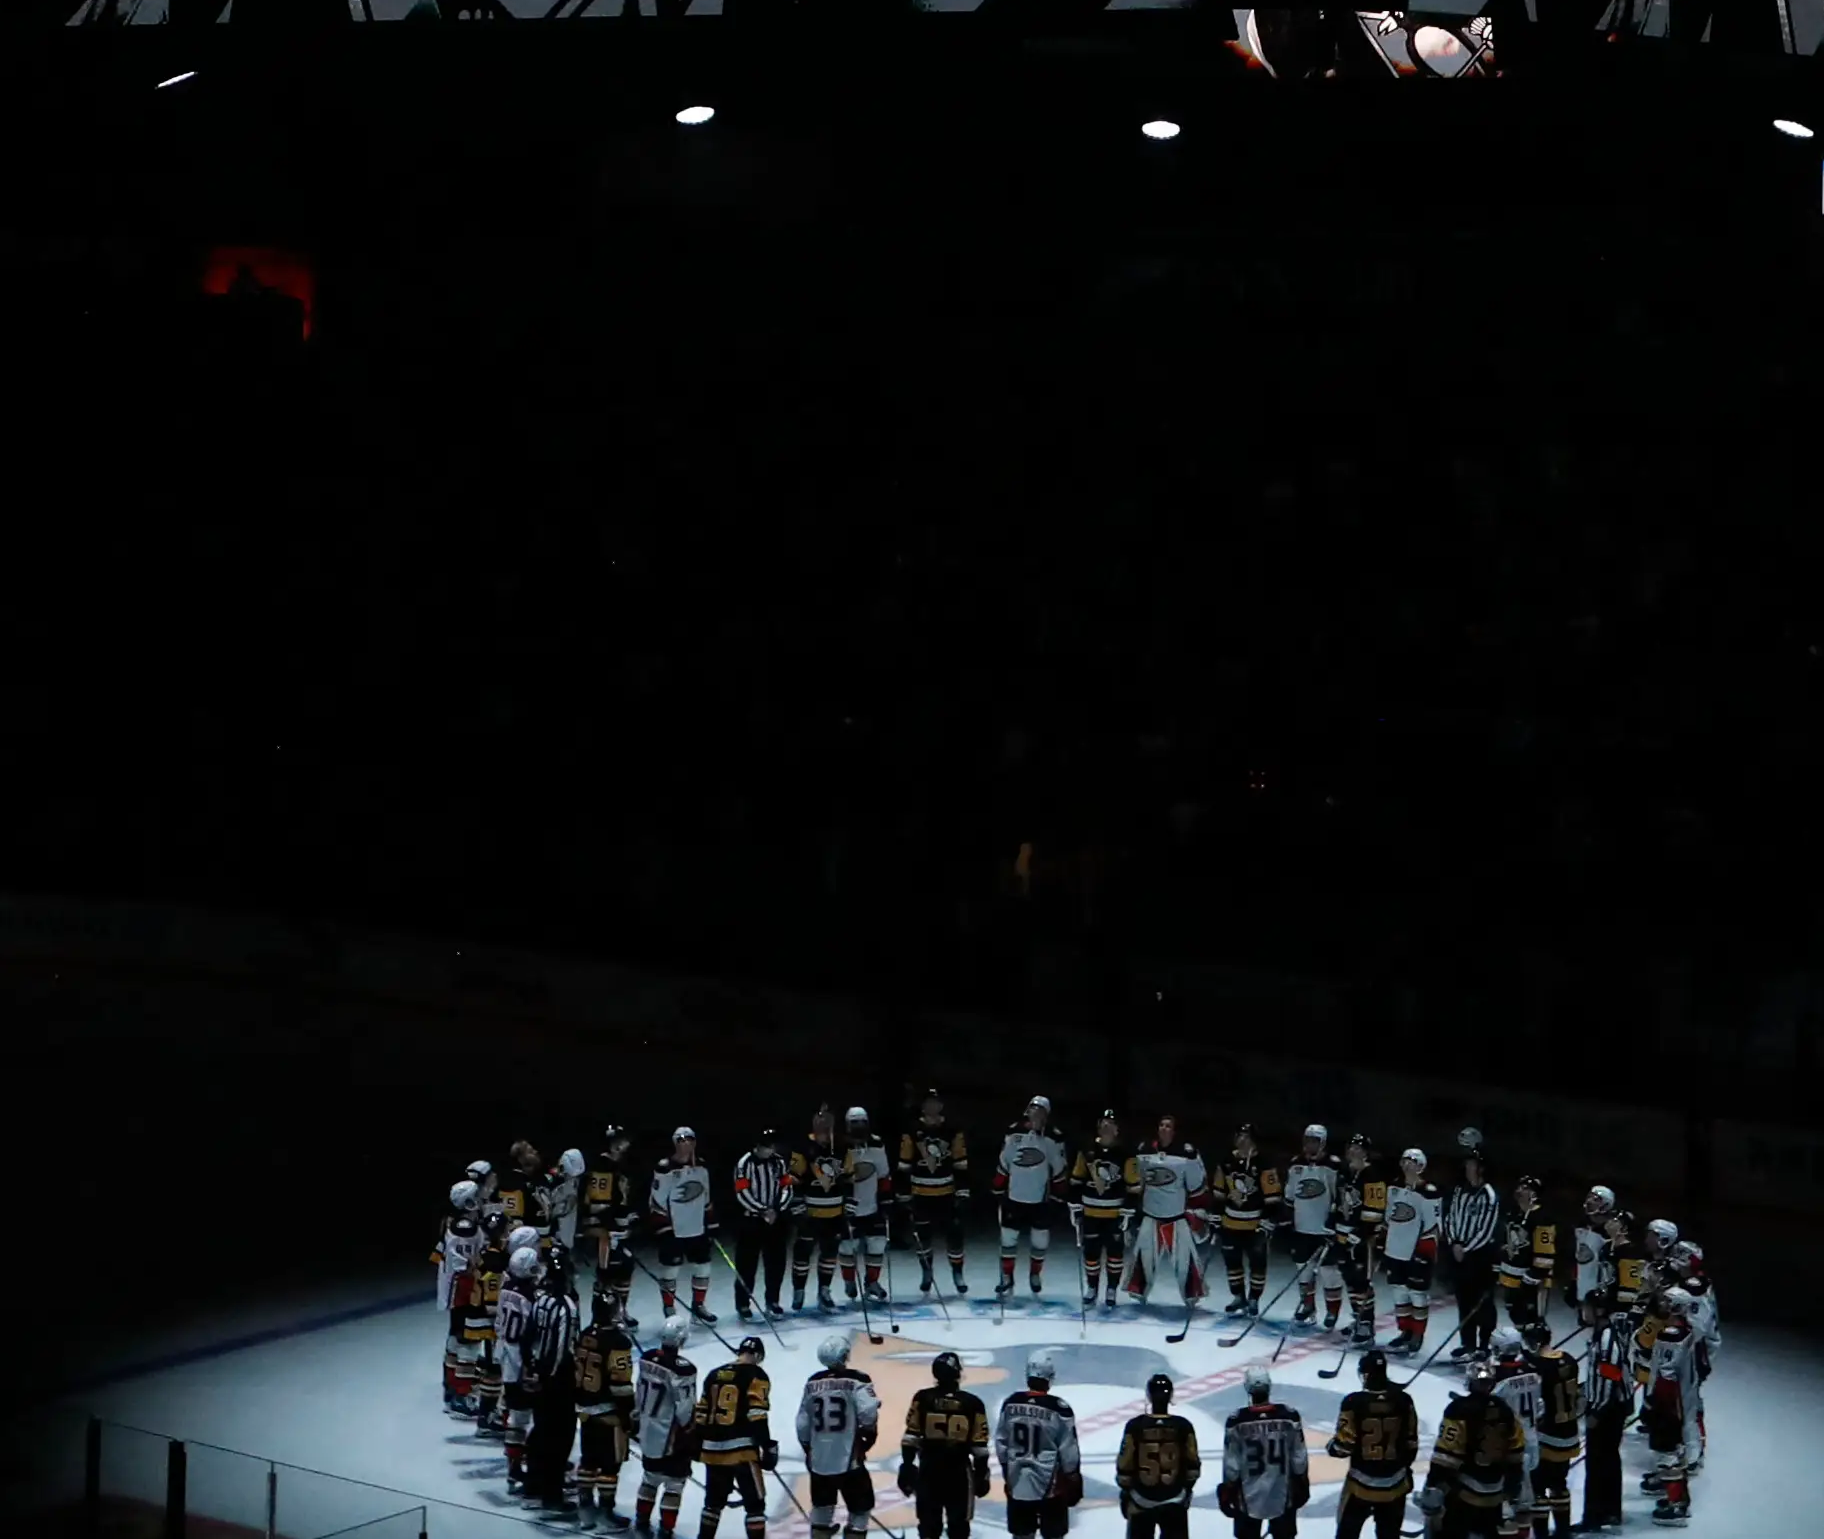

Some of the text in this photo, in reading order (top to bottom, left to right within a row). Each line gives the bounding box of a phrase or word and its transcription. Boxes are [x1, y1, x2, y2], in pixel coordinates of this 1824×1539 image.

[812, 1396, 848, 1432] 33
[1013, 1422, 1041, 1459] 91
[1246, 1438, 1286, 1476] 34
[1360, 1416, 1403, 1462] 27
